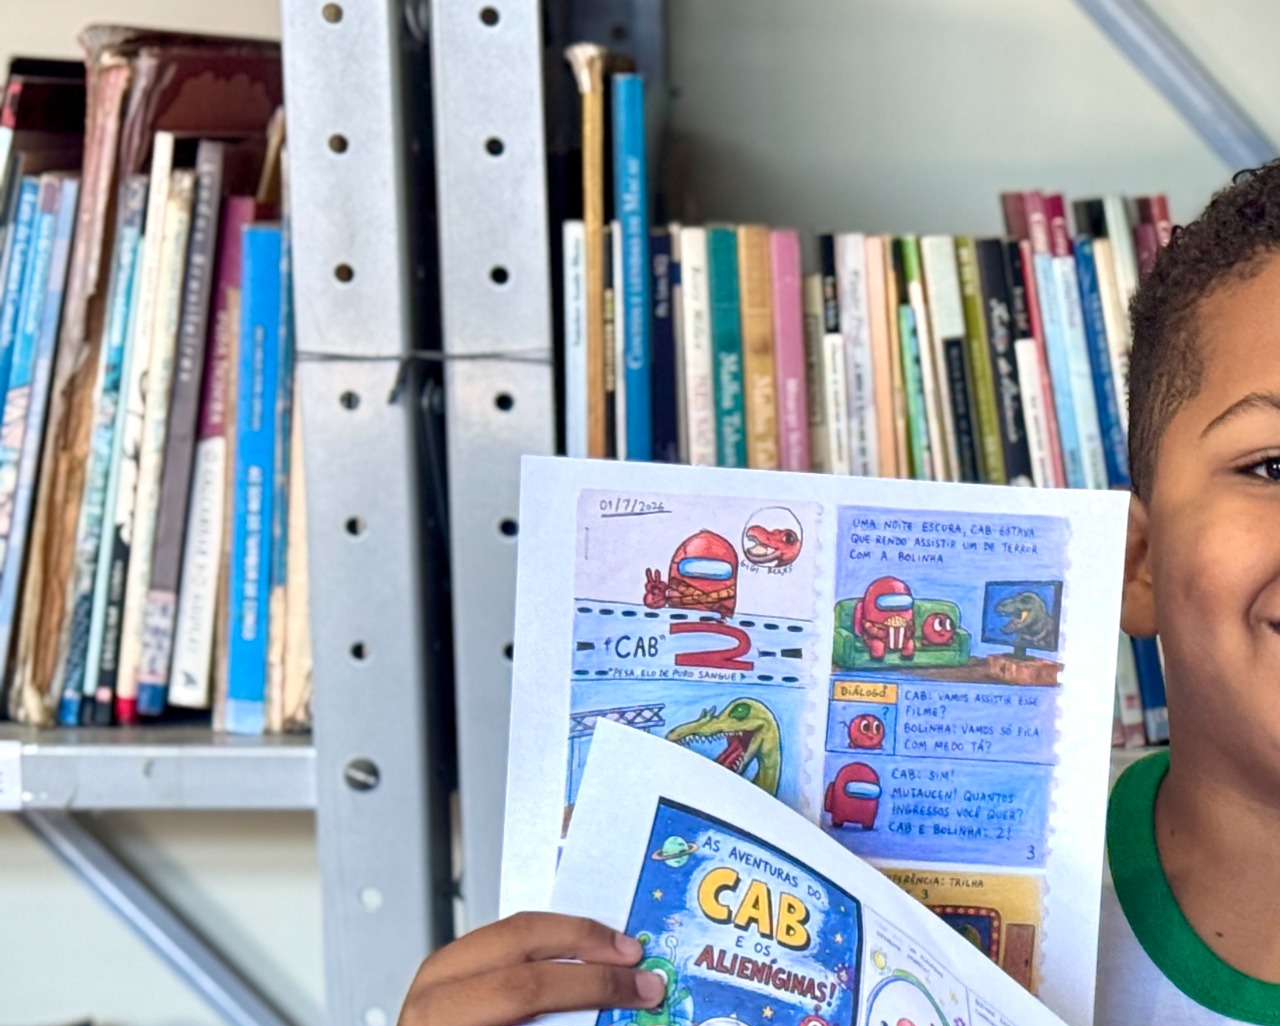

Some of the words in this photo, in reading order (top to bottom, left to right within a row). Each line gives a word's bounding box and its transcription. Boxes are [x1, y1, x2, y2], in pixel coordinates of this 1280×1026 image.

[852, 519, 876, 530] UMA
[884, 520, 913, 532] NOITE
[922, 521, 967, 537] ESCURA,
[970, 524, 992, 536] CAB
[1000, 526, 1035, 537] ESTAVA
[850, 533, 871, 545] QUE
[914, 537, 956, 549] ASSISTIR
[962, 541, 977, 551] UM
[1002, 543, 1038, 554] TERROR
[849, 550, 871, 561] COM
[881, 551, 888, 561] A
[898, 551, 944, 563] BOLINHA
[669, 621, 755, 671] 2
[905, 705, 947, 717] FILME?
[961, 724, 995, 736] VAMOS
[904, 739, 927, 750] COM
[934, 740, 965, 751] MEDO
[971, 740, 992, 752] TÁ?
[928, 769, 955, 781] SIM!
[963, 790, 1014, 804] QUANTOS
[891, 803, 950, 818] INGRESSOS
[956, 804, 981, 818] VOCÊ
[987, 808, 1024, 821] QUER?
[888, 821, 912, 834] CAB
[919, 823, 926, 834] E
[1026, 844, 1036, 860] 3
[702, 835, 721, 853] AS
[728, 846, 799, 888] AVENTURAS
[807, 885, 823, 901] DO
[950, 876, 984, 889] TRILHA
[697, 866, 811, 952] CAB
[735, 935, 745, 948] E
[754, 942, 771, 957] OS
[694, 944, 838, 1008] ALIENÍGINAS!
